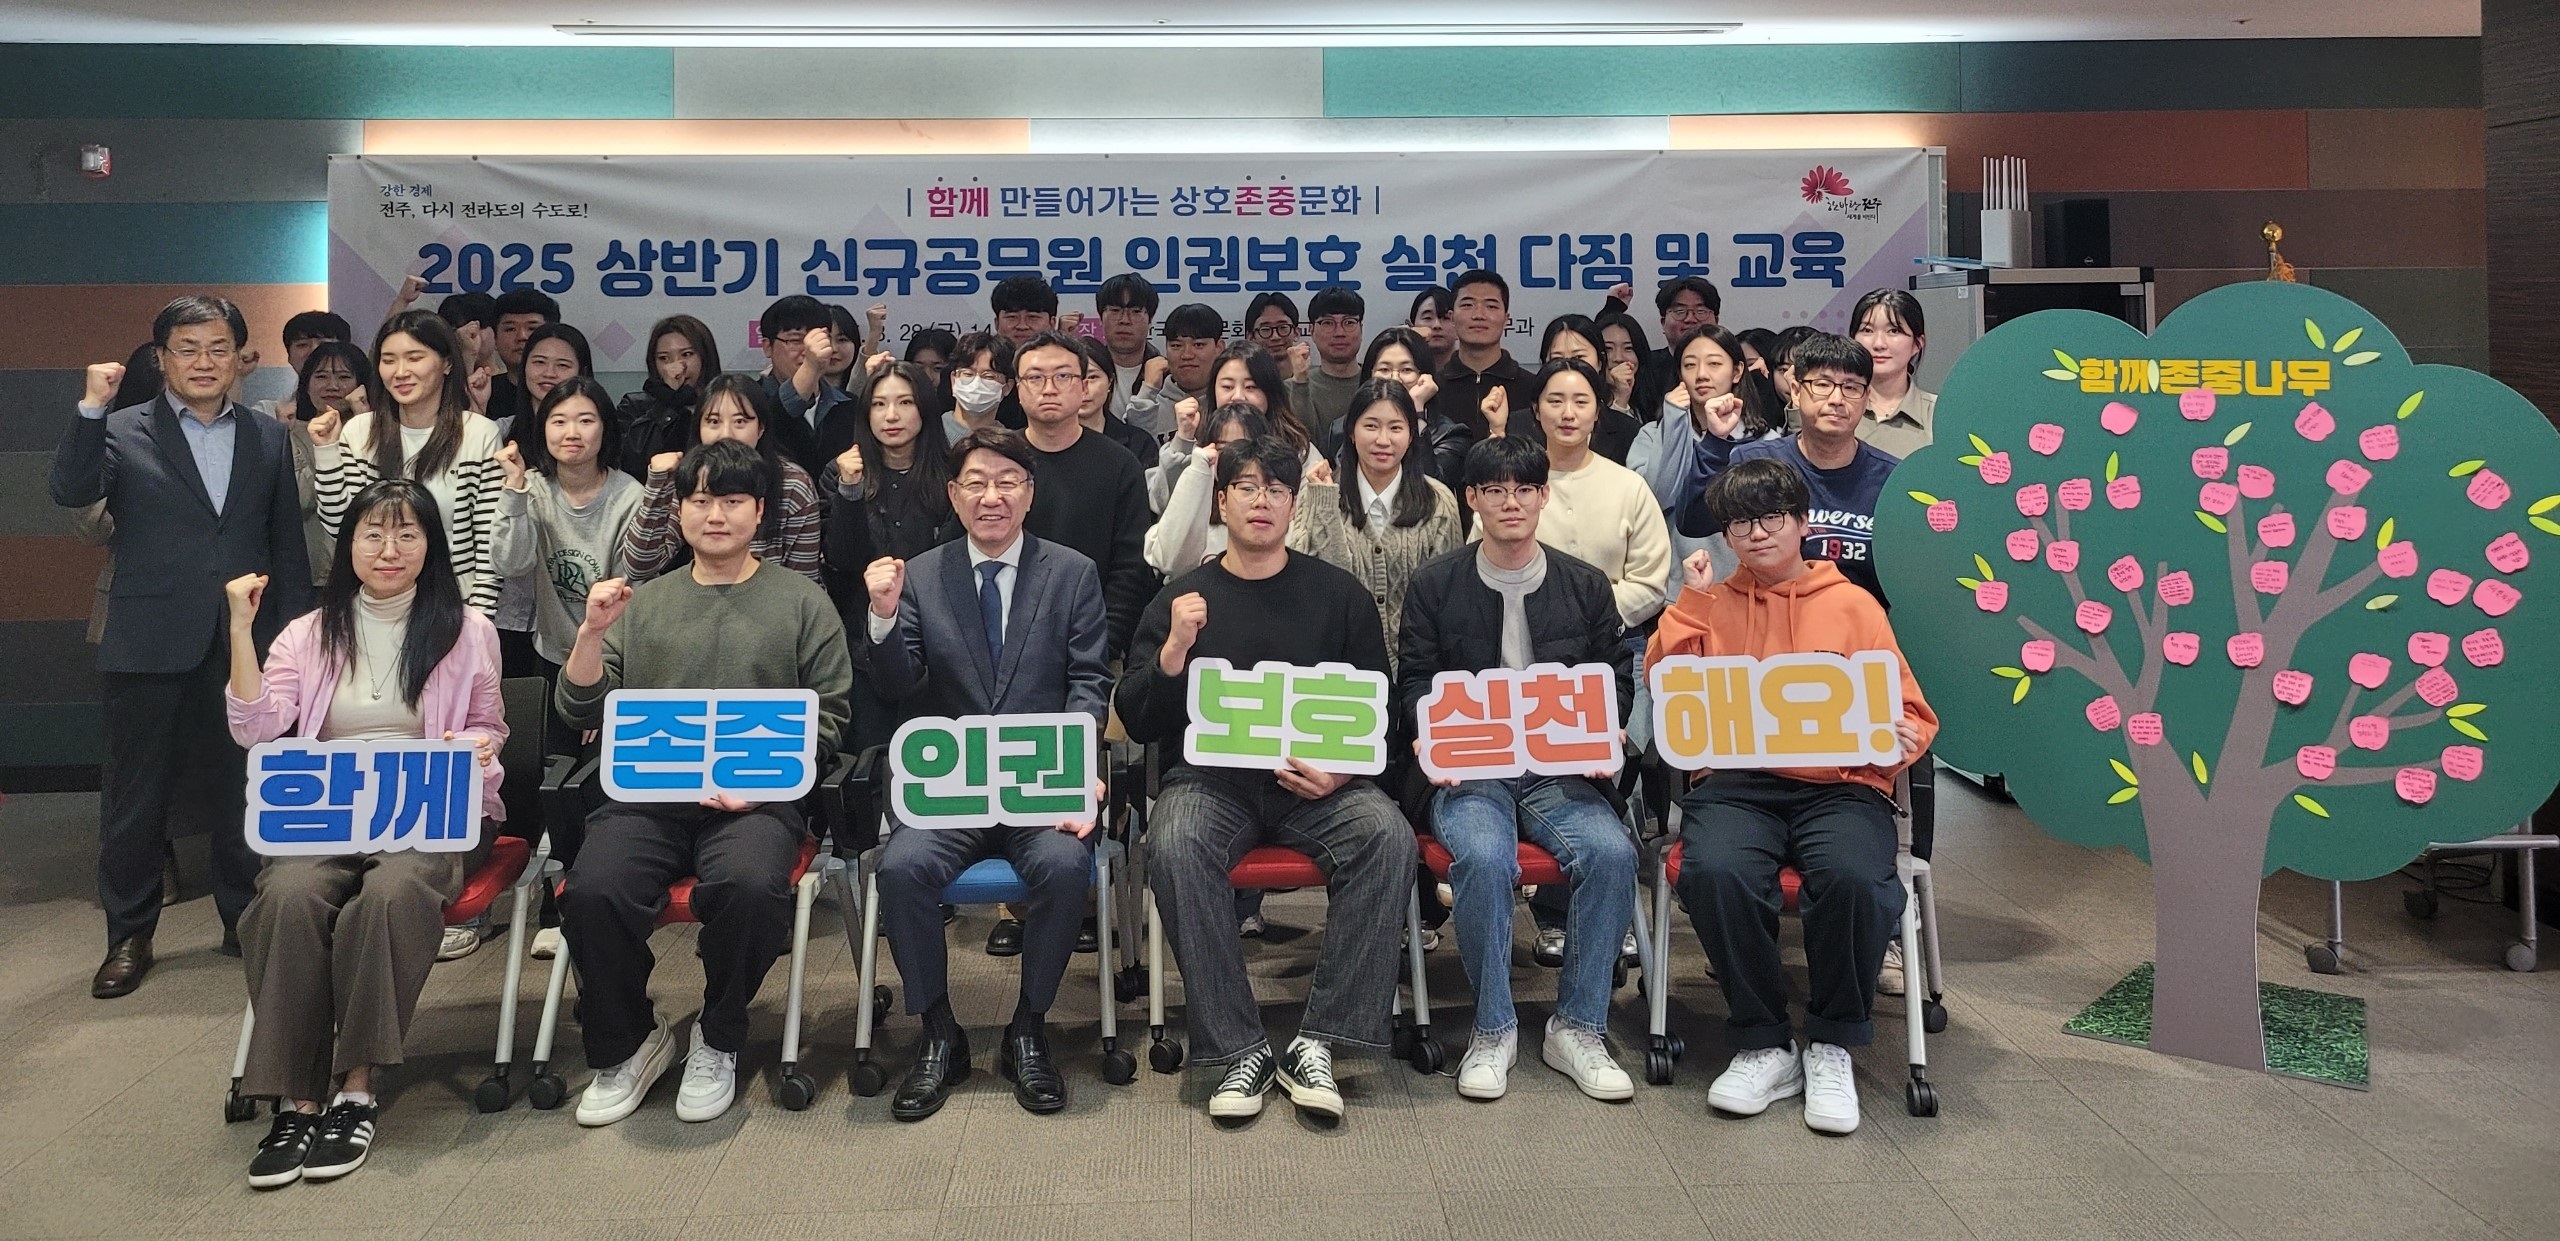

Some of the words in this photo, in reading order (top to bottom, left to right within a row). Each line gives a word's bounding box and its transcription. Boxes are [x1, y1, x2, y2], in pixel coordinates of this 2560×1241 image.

[379, 184, 406, 198] 강한
[409, 184, 433, 198] 경제
[379, 201, 416, 219] 전주,
[422, 201, 454, 219] 다시
[460, 201, 525, 219] 전라도의
[531, 202, 588, 219] 수도로!
[926, 186, 990, 218] 함께
[1000, 186, 1160, 217] 만들어가는
[1169, 185, 1362, 217] 상호존중문화
[418, 243, 575, 295] 2025
[597, 238, 780, 297] 상반기
[800, 237, 1103, 297] 신규공무원
[1125, 235, 1363, 294] 인권보호
[1381, 234, 1498, 294] 실천
[1520, 233, 1633, 290] 다짐
[1655, 232, 1710, 289] 및
[1731, 231, 1847, 288] 교육
[1820, 539, 1867, 561] 1932
[612, 700, 808, 790] 존중
[1196, 668, 1376, 762] 보호
[1428, 674, 1612, 770] 실천
[1662, 662, 1895, 756] 해요!
[258, 749, 473, 844] 함께
[900, 724, 1087, 818] 인권
